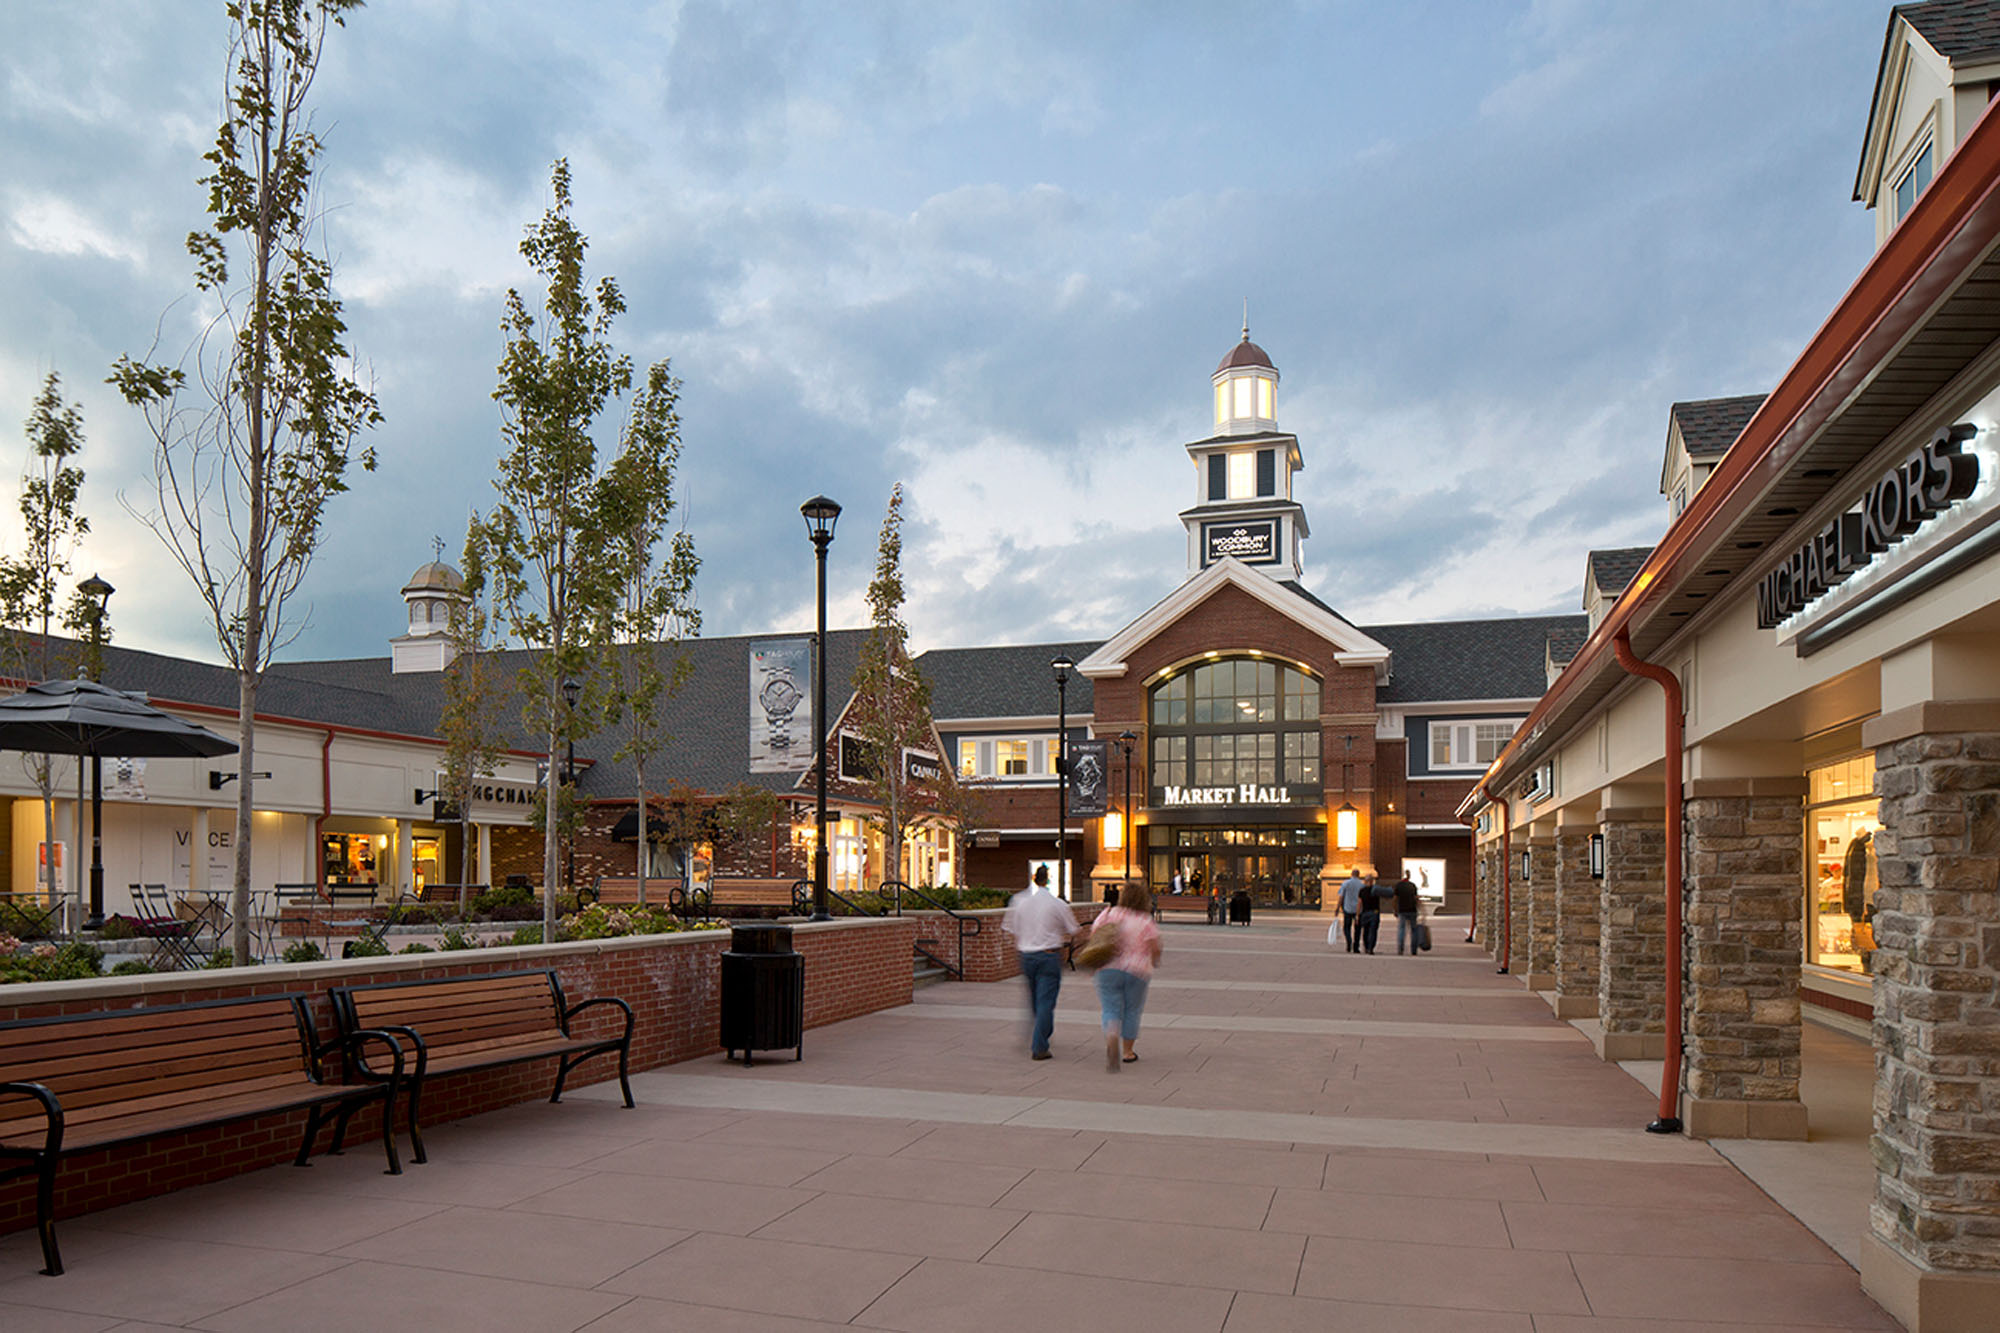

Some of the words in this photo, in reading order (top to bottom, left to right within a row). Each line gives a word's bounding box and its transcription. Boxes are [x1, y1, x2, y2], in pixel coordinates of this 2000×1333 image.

[1757, 509, 1866, 629] MICHAEL
[1862, 424, 1974, 553] KORS
[1211, 534, 1269, 546] WOODBURY
[1217, 542, 1263, 551] COMMON
[1164, 786, 1235, 805] MARKET
[1240, 784, 1291, 803] HALL
